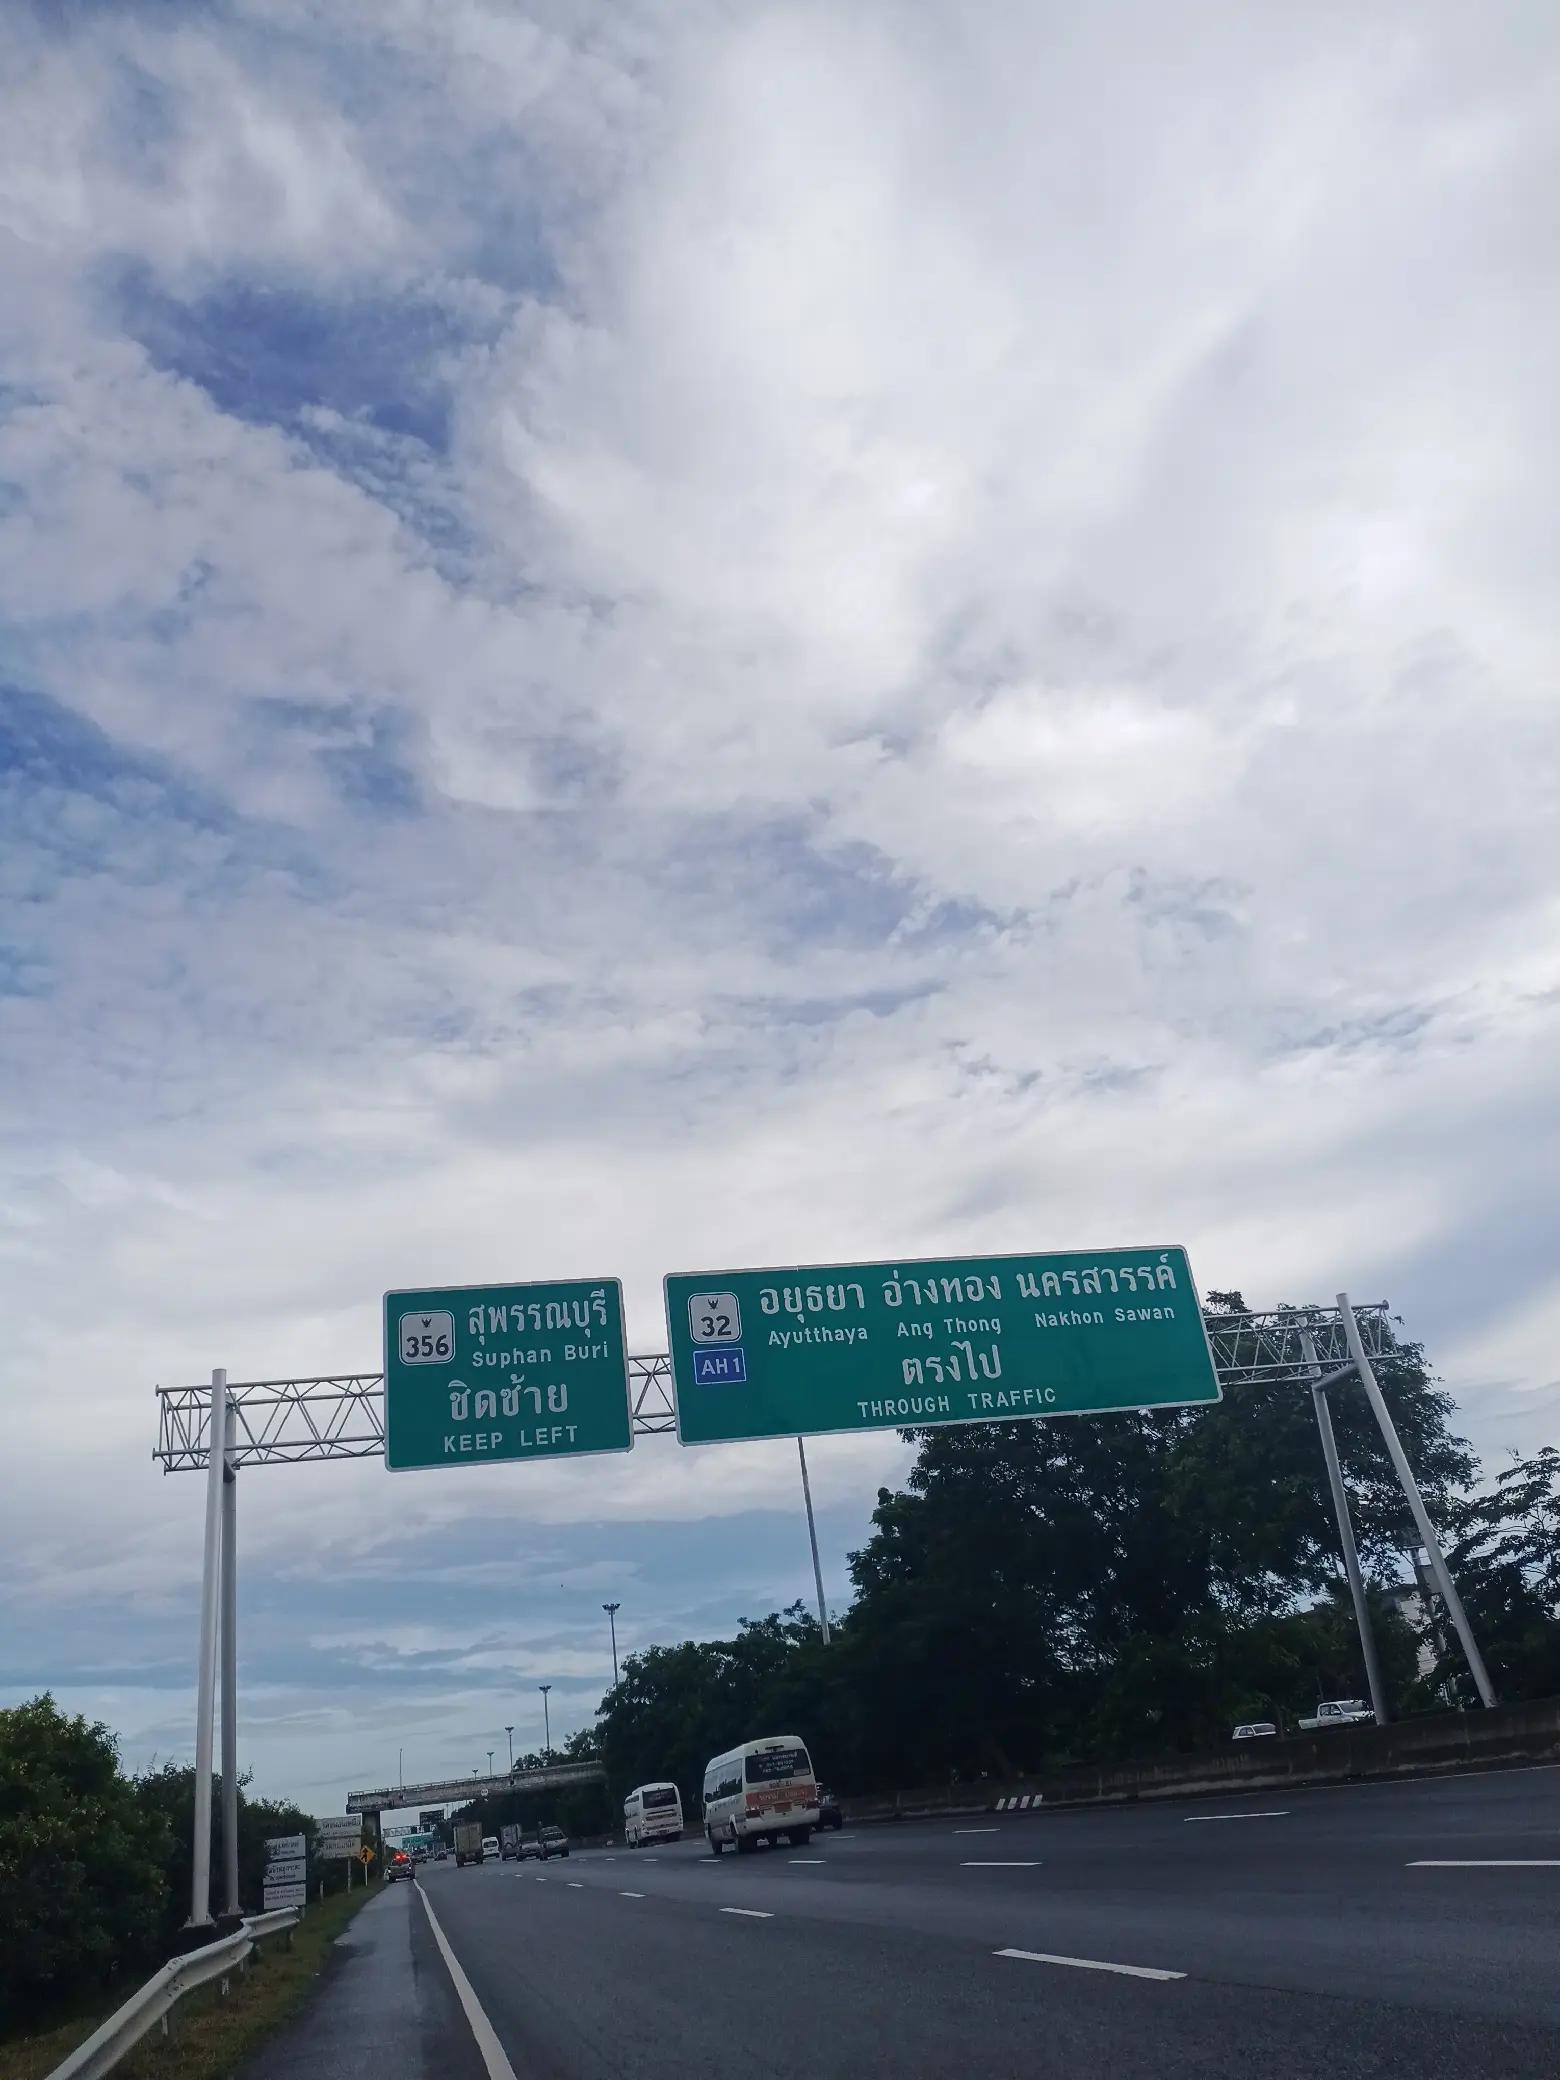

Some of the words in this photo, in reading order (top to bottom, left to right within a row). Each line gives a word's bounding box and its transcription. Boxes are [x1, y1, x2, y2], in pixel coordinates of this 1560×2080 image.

[759, 1283, 865, 1324] อยุธยา
[881, 1269, 1001, 1307] อ่างทอง
[1016, 1253, 1177, 1299] นครสวรรค์
[468, 1288, 607, 1346] สุพรรณบุรี
[701, 1315, 732, 1337] 32
[768, 1326, 868, 1348] Ayutthaya
[897, 1321, 933, 1340] Ang
[944, 1316, 1001, 1335] Thong
[1034, 1310, 1104, 1328] Nakhon
[1115, 1306, 1175, 1322] Sawan
[406, 1334, 450, 1359] 356
[472, 1347, 552, 1368] Suphan
[564, 1341, 609, 1361] Buri
[902, 1340, 1002, 1385] ตรงไป
[448, 1373, 568, 1421] ชิดซ้าย
[857, 1397, 950, 1418] THROUGH
[967, 1388, 1056, 1410] TRAFFIC
[444, 1432, 503, 1453] KEEP
[521, 1425, 578, 1447] LEFT
